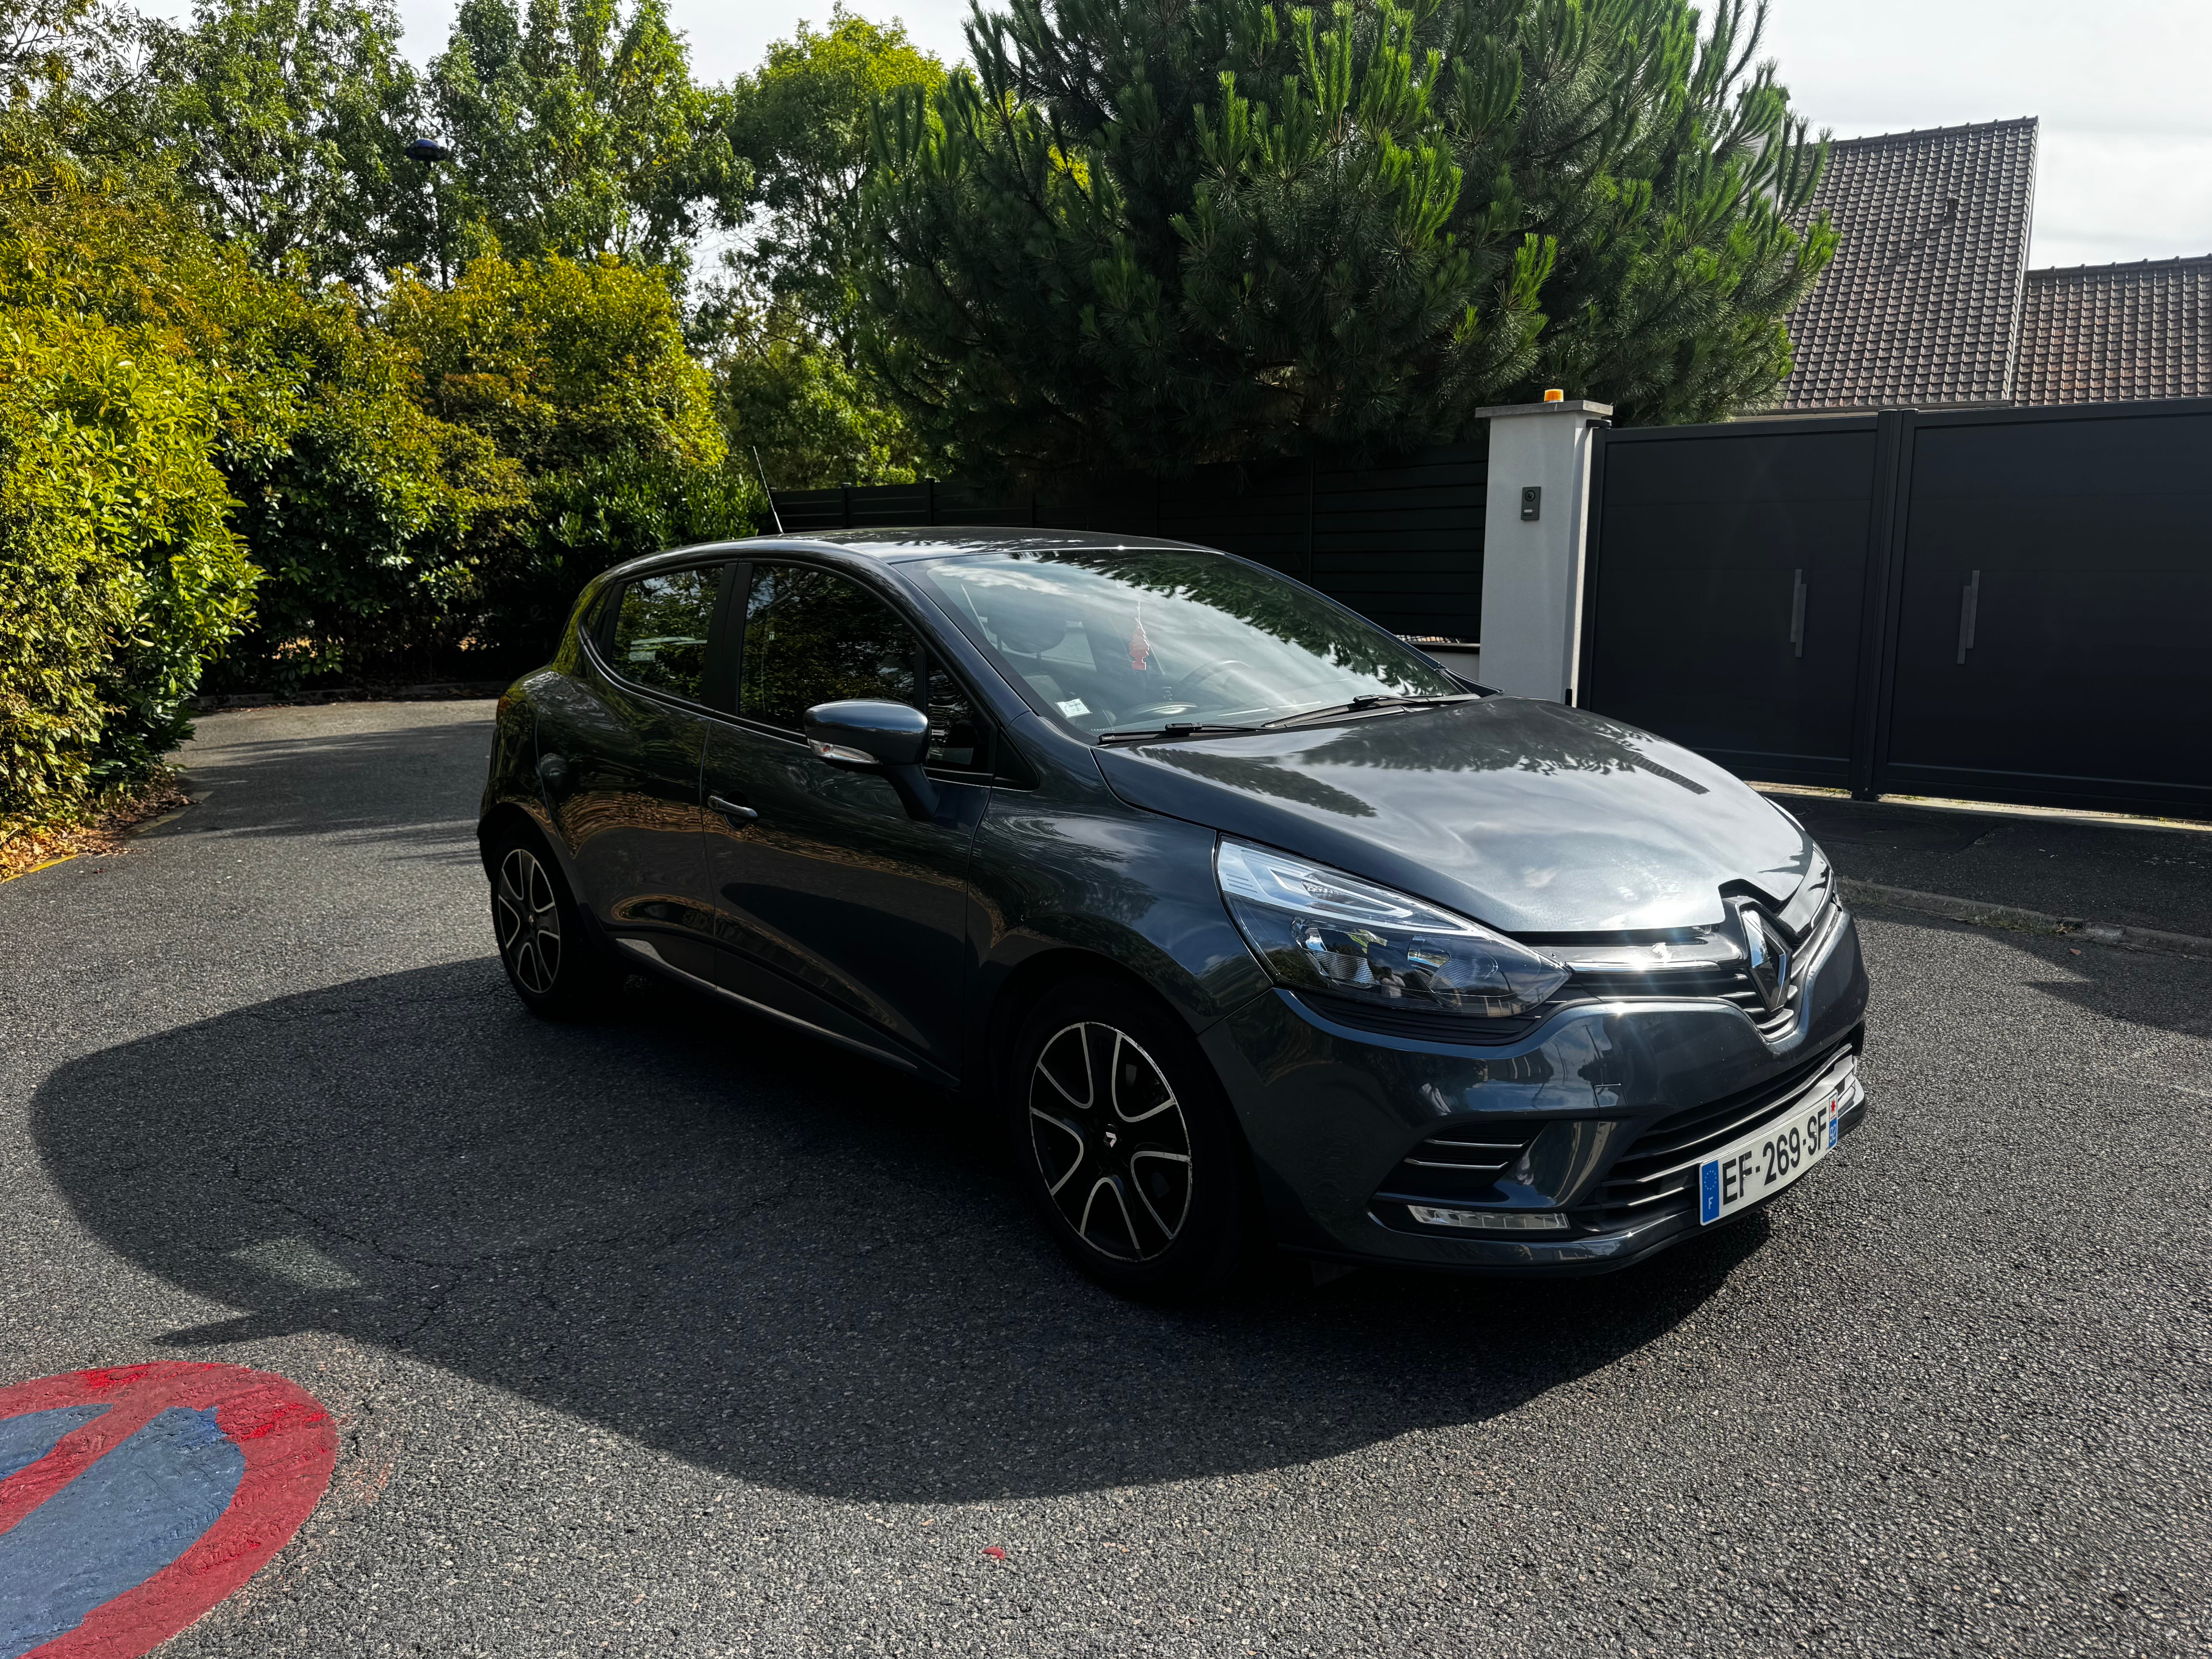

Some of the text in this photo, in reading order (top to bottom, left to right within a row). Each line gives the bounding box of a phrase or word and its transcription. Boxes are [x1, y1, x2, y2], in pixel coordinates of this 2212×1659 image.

[1829, 1123, 1836, 1143] 92
[1723, 1106, 1827, 1206] EF-269-SF
[1708, 1196, 1714, 1209] F
